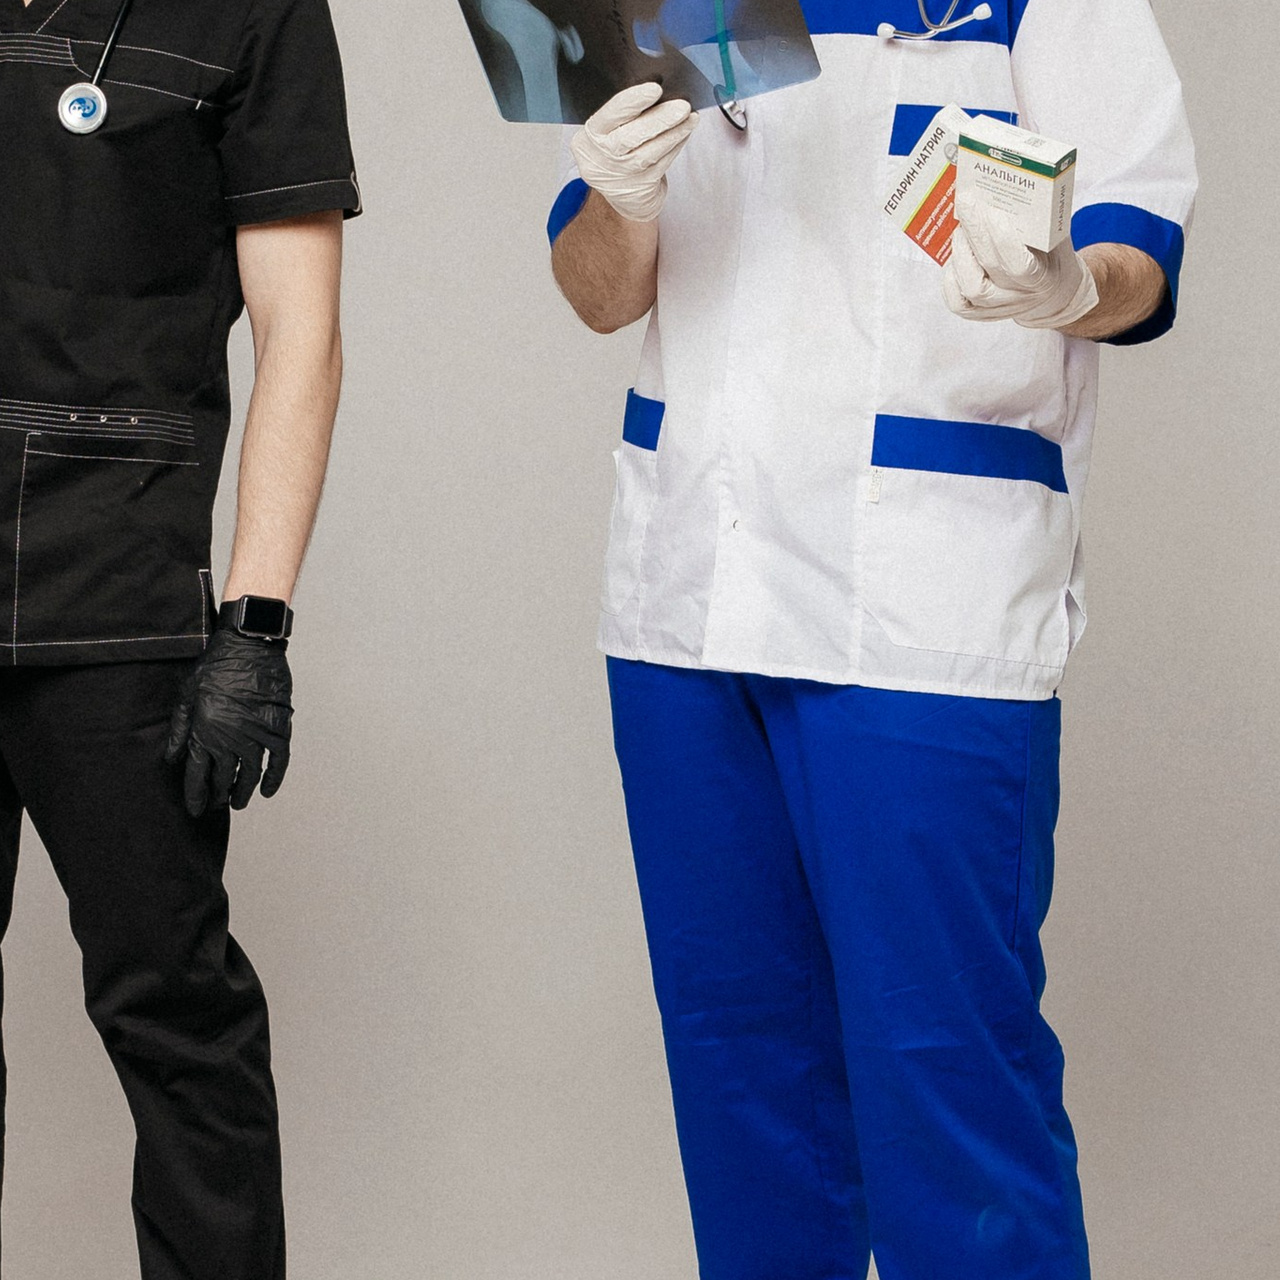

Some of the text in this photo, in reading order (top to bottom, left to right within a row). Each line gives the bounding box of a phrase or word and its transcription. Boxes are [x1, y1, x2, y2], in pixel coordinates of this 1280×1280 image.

[883, 126, 946, 216] ГЕПАРИН НАТРИЯ
[973, 162, 1036, 190] АНАЛЬГИН
